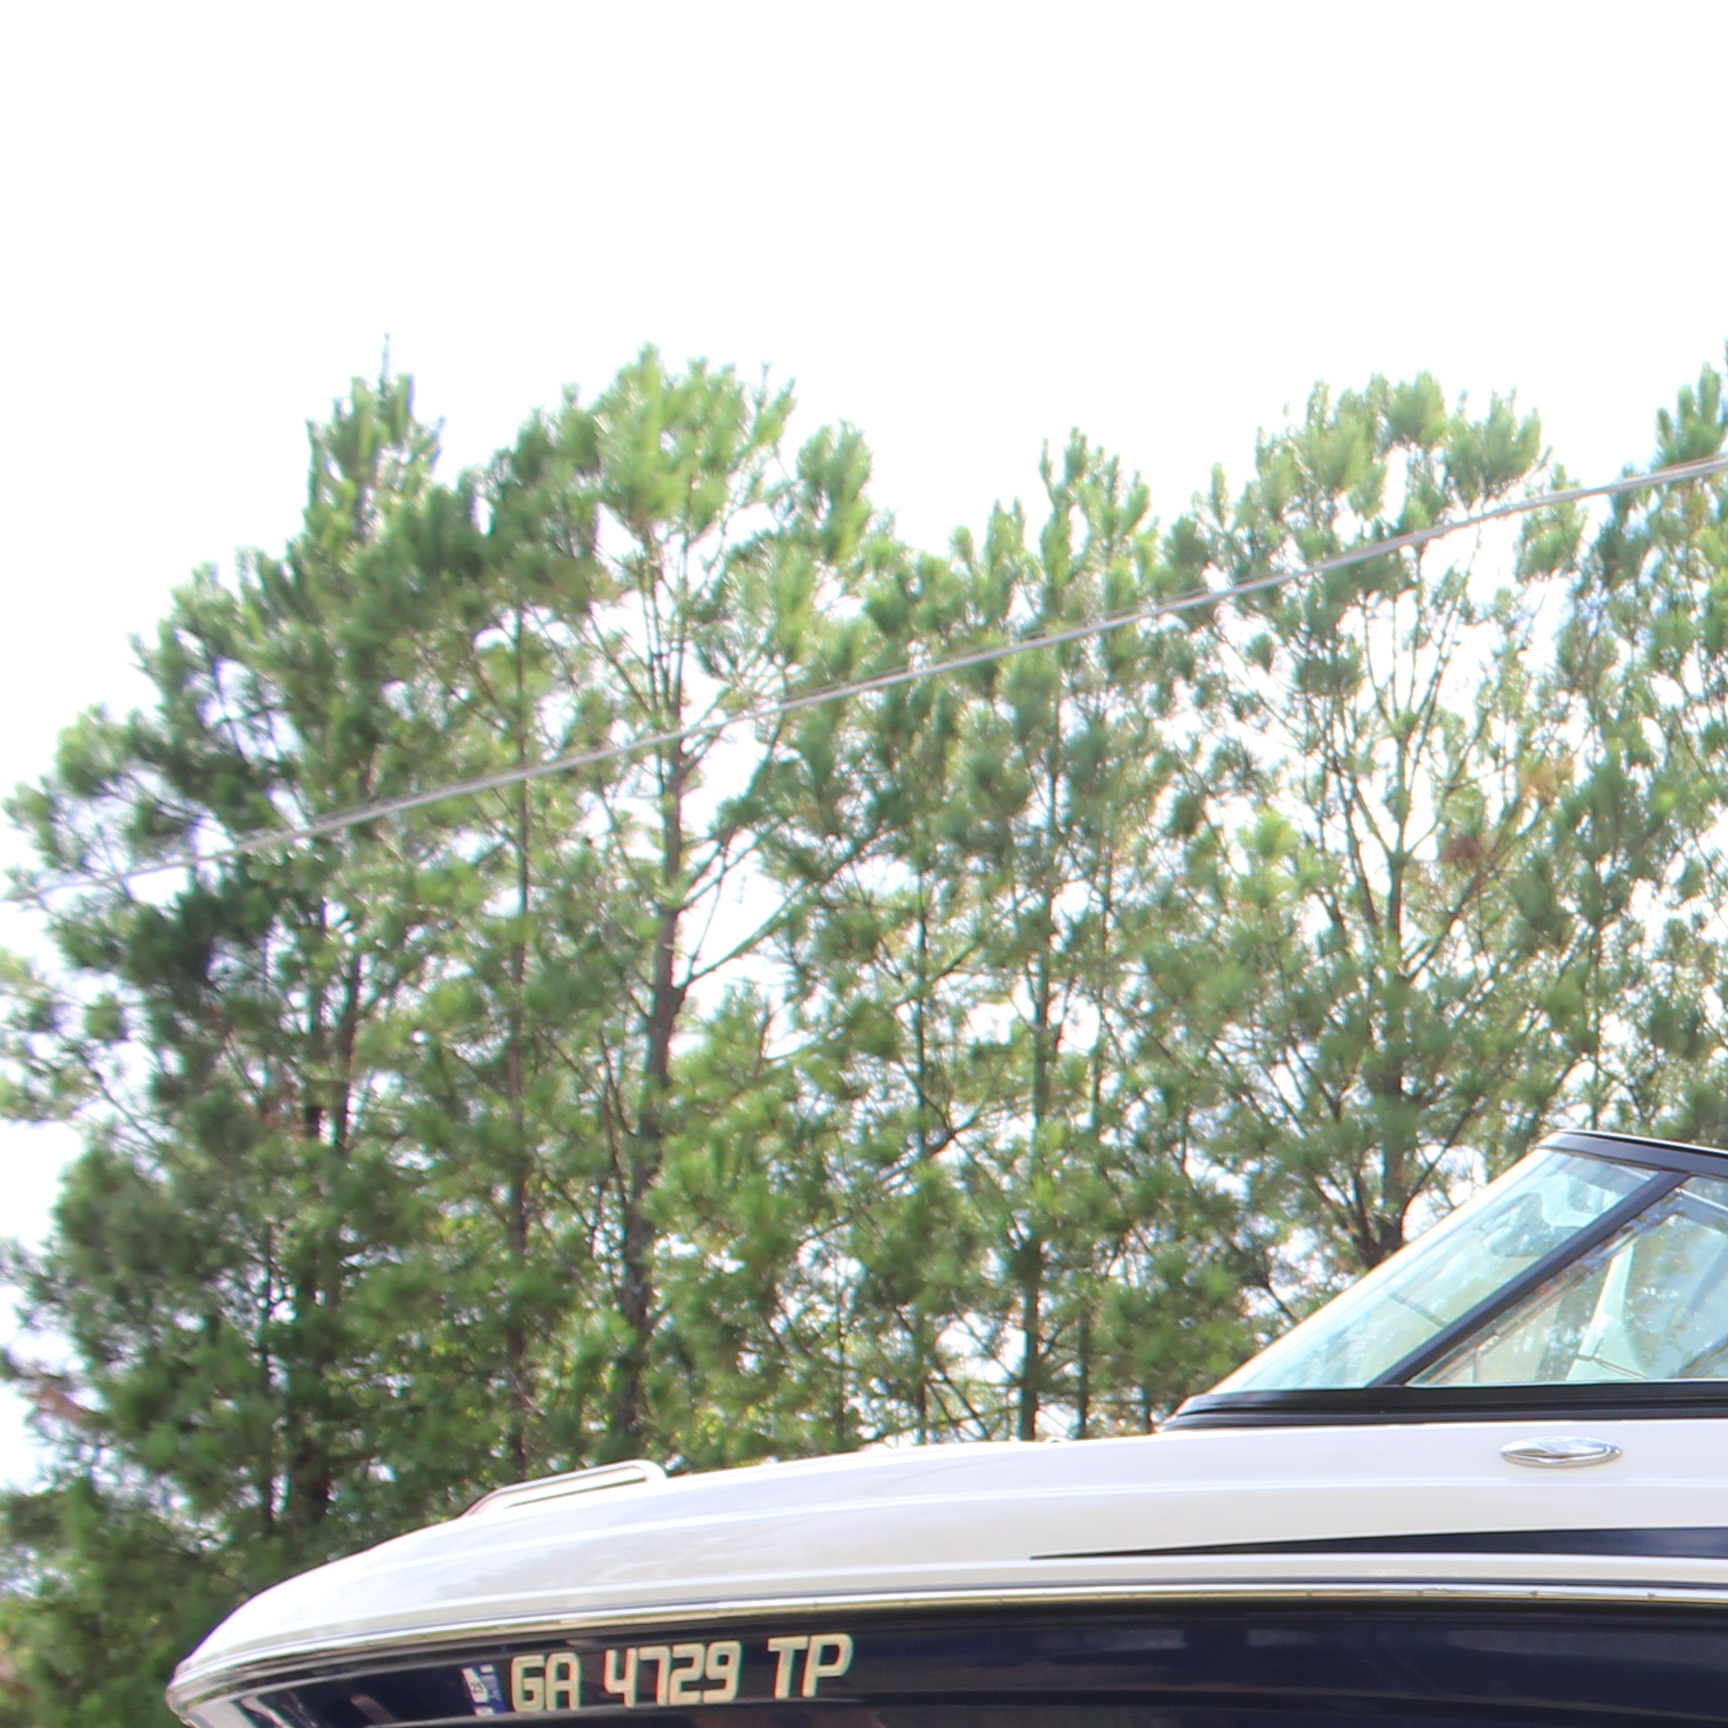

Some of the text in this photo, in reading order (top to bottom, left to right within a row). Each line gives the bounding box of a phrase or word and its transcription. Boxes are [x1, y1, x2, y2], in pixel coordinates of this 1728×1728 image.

[511, 1633, 854, 1713] GA 4729 TP
